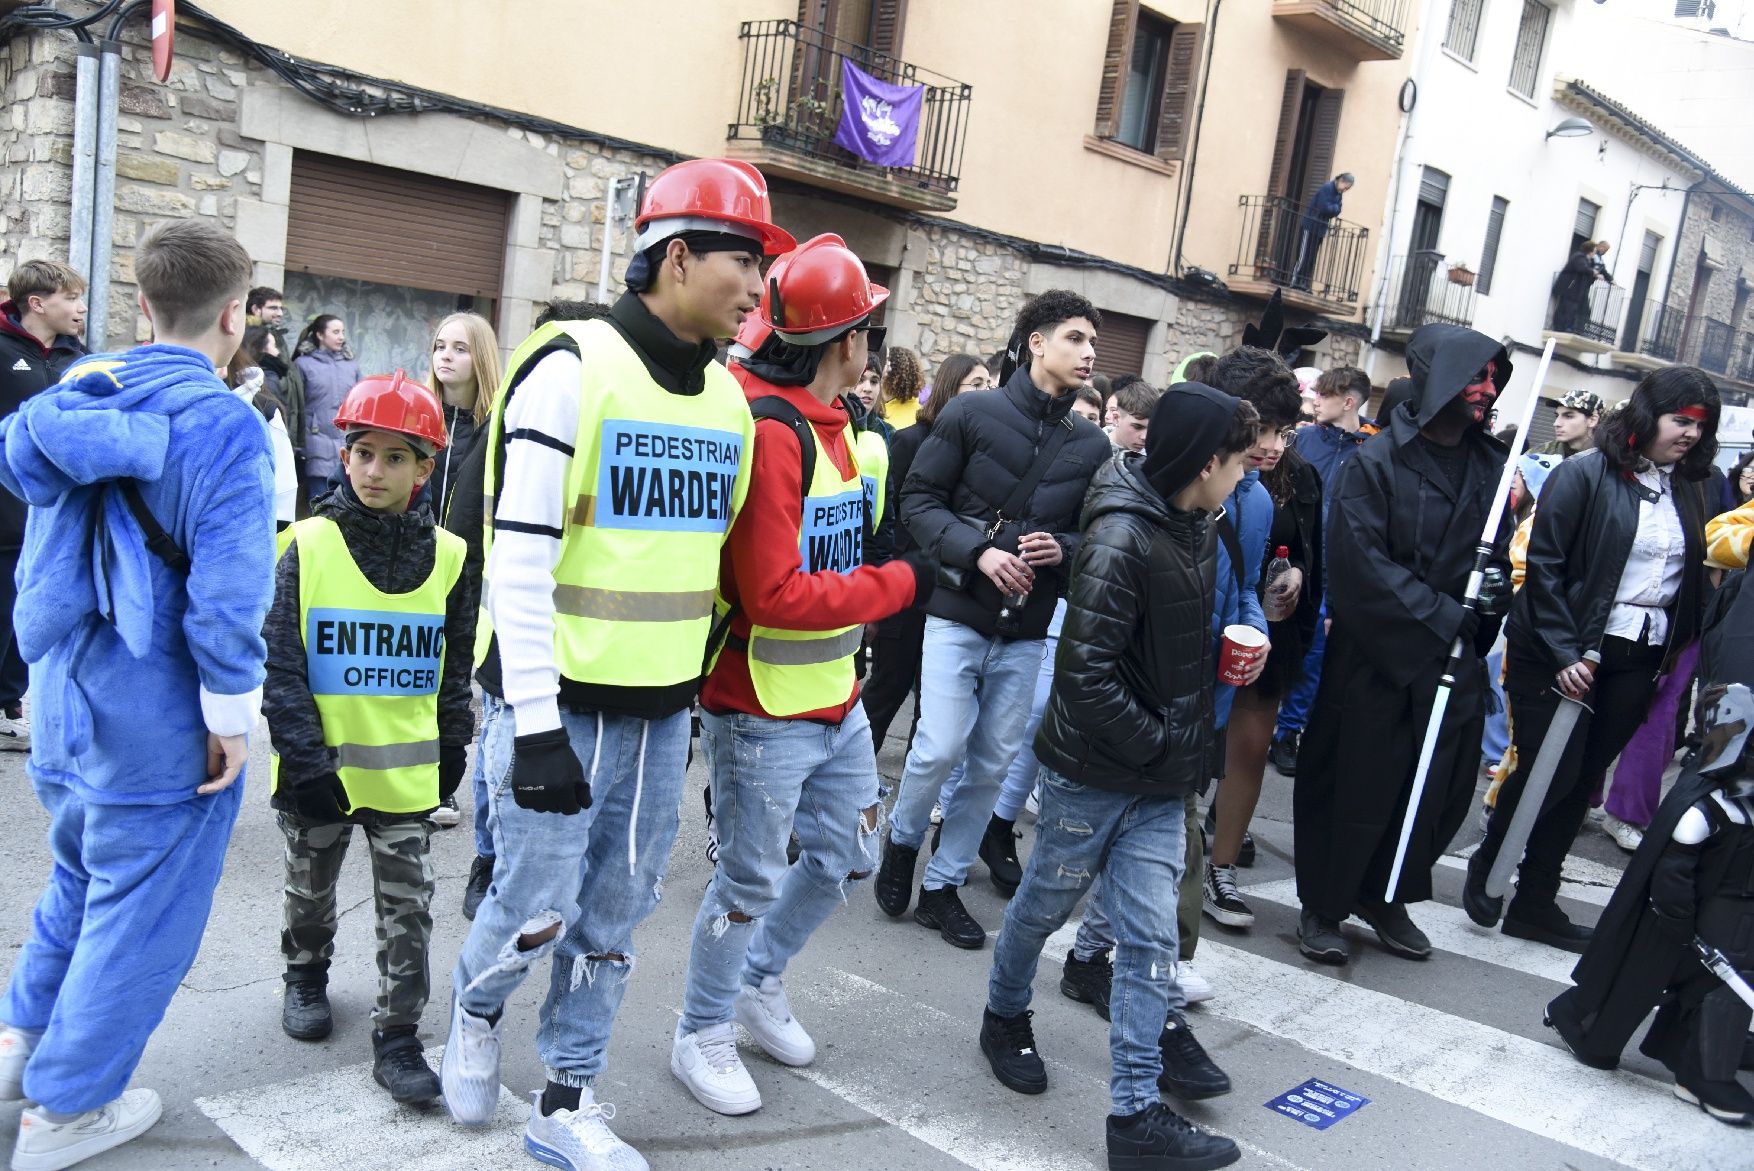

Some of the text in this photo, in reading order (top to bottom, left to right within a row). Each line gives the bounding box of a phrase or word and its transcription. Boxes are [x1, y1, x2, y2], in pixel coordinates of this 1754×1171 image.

[615, 432, 741, 466] PEDESTRIAN
[316, 620, 444, 660] ENTRANC
[343, 666, 436, 690] OFFICER
